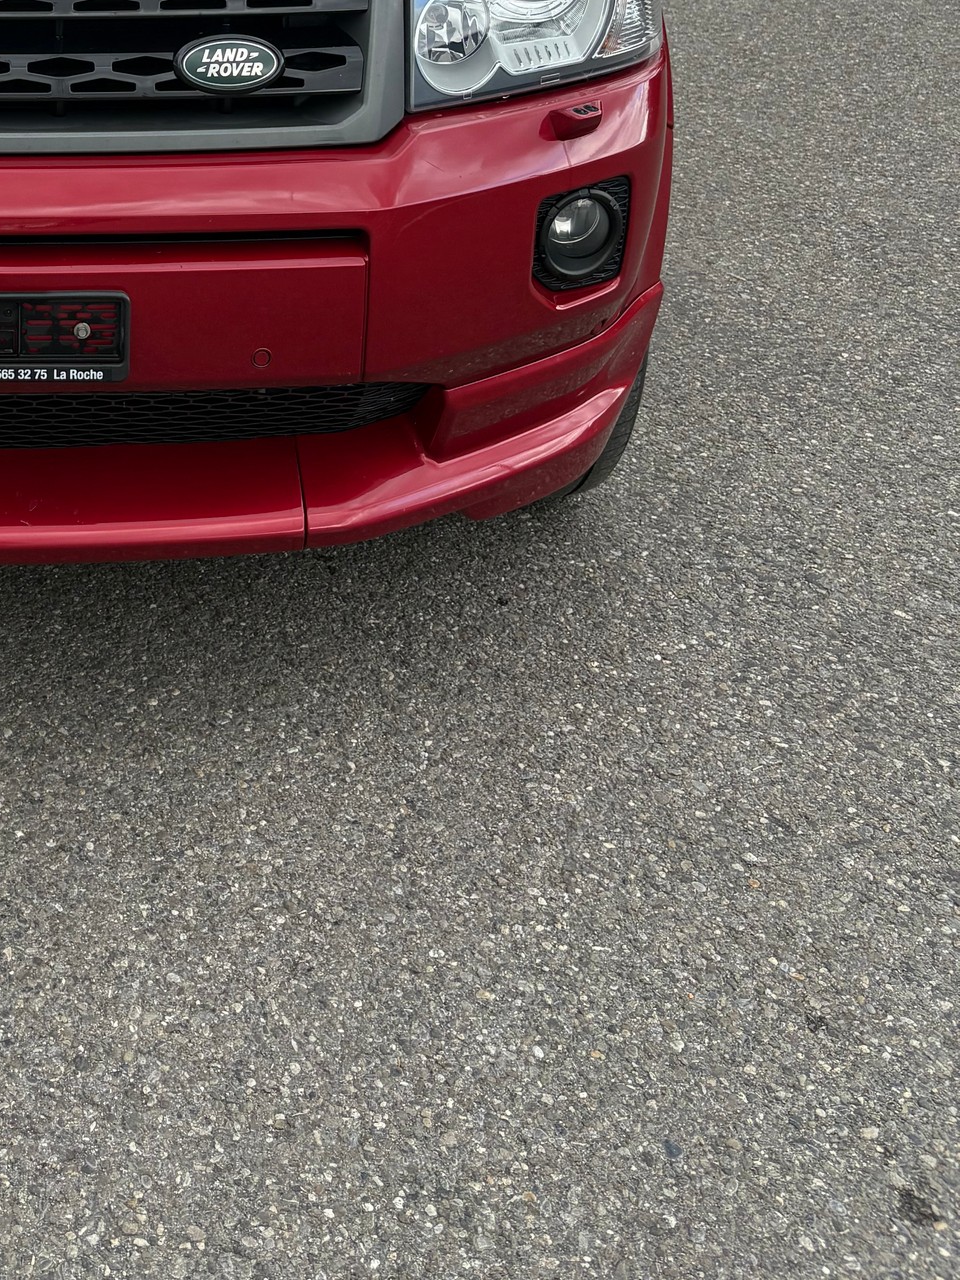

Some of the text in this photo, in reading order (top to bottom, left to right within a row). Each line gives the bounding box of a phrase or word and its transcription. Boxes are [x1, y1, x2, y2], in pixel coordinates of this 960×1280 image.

[202, 48, 248, 62] LAND
[207, 62, 263, 77] ROVER
[18, 369, 31, 380] 32
[34, 369, 47, 380] 75
[53, 369, 66, 380] La
[69, 369, 103, 380] Roche
